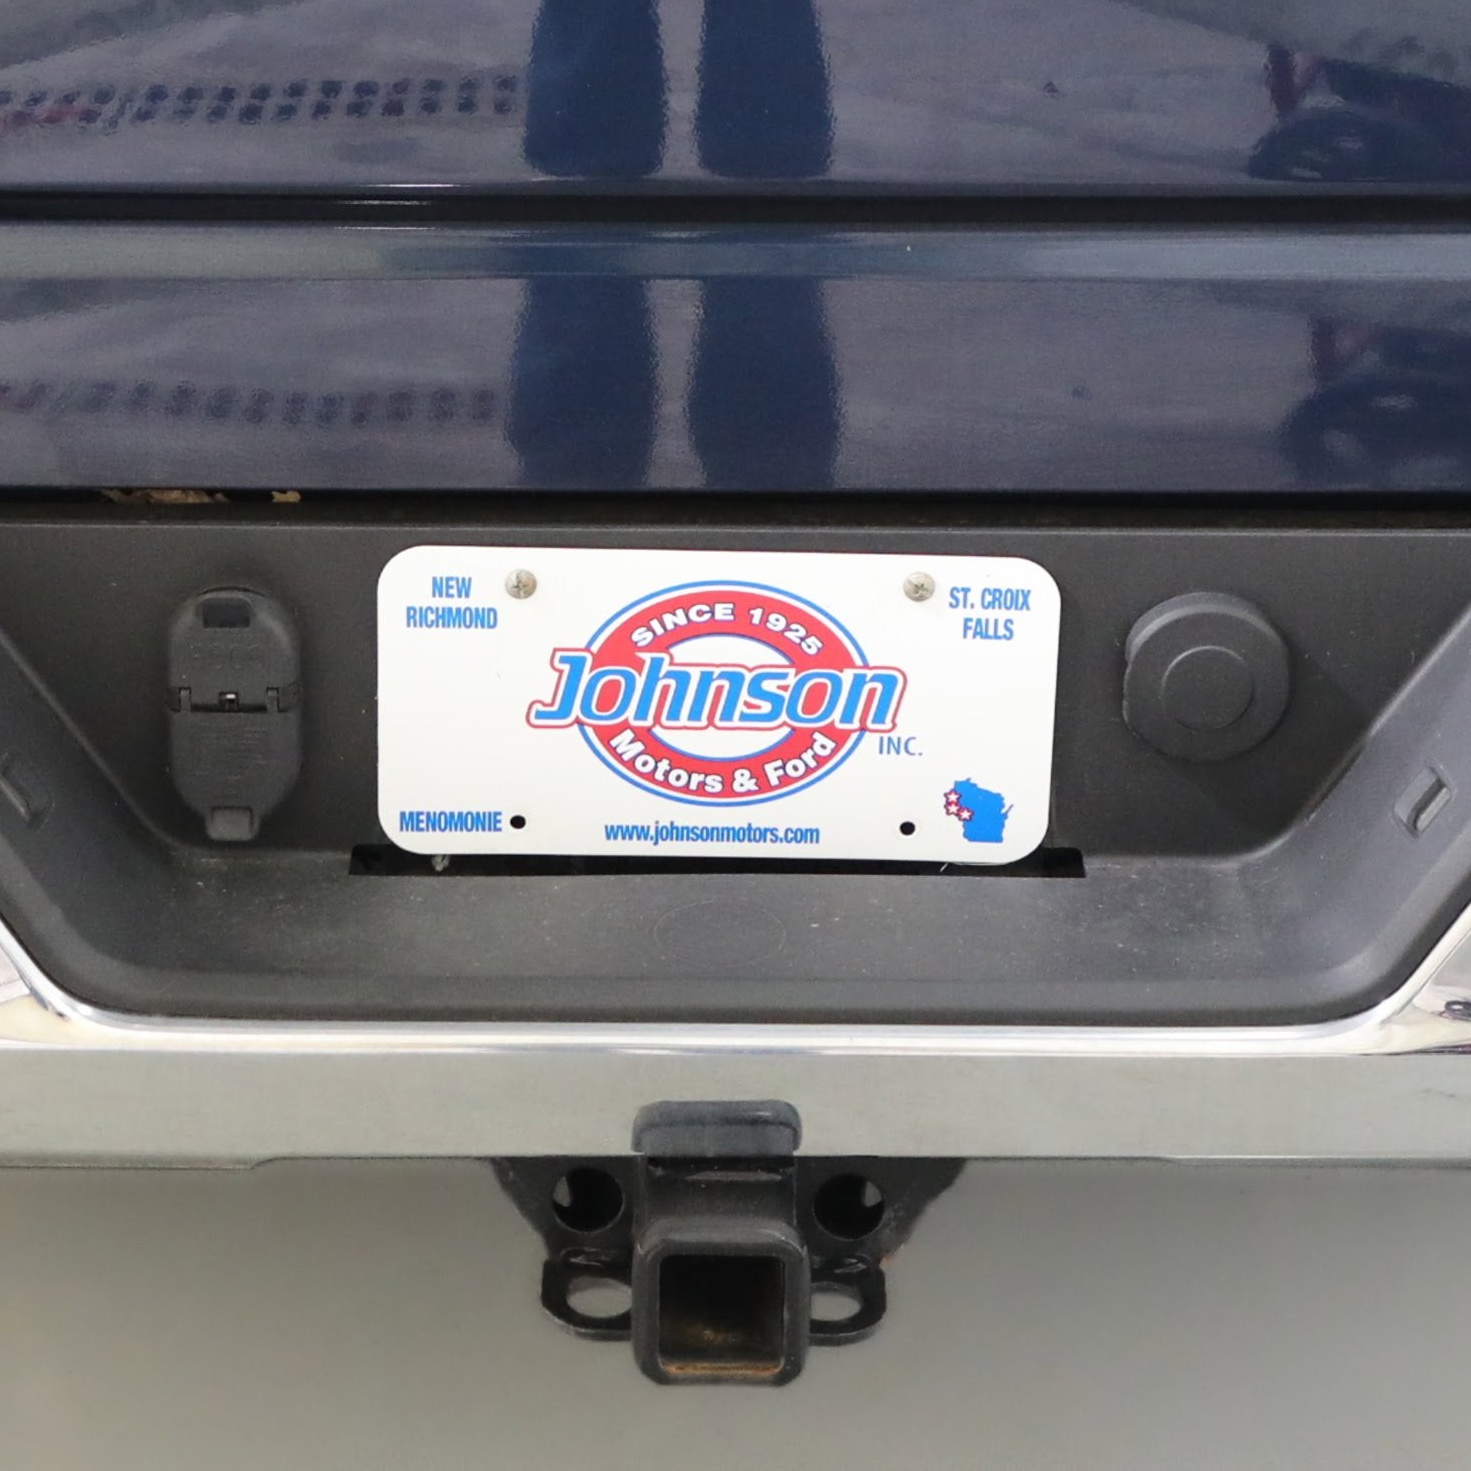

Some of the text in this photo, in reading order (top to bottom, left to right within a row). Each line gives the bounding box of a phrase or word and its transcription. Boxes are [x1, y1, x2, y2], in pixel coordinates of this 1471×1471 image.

[431, 576, 472, 600] NEW
[949, 587, 1032, 612] ST. CROIX
[405, 607, 498, 630] RICHMOND
[631, 602, 824, 656] SINCE 1925
[962, 617, 1015, 641] FALLS
[529, 650, 904, 730] Johnson
[878, 735, 924, 757] INC.
[609, 728, 838, 794] Motors & Ford
[399, 811, 503, 834] MENOMONIE
[604, 820, 820, 846] www.johnsonmotors.com
